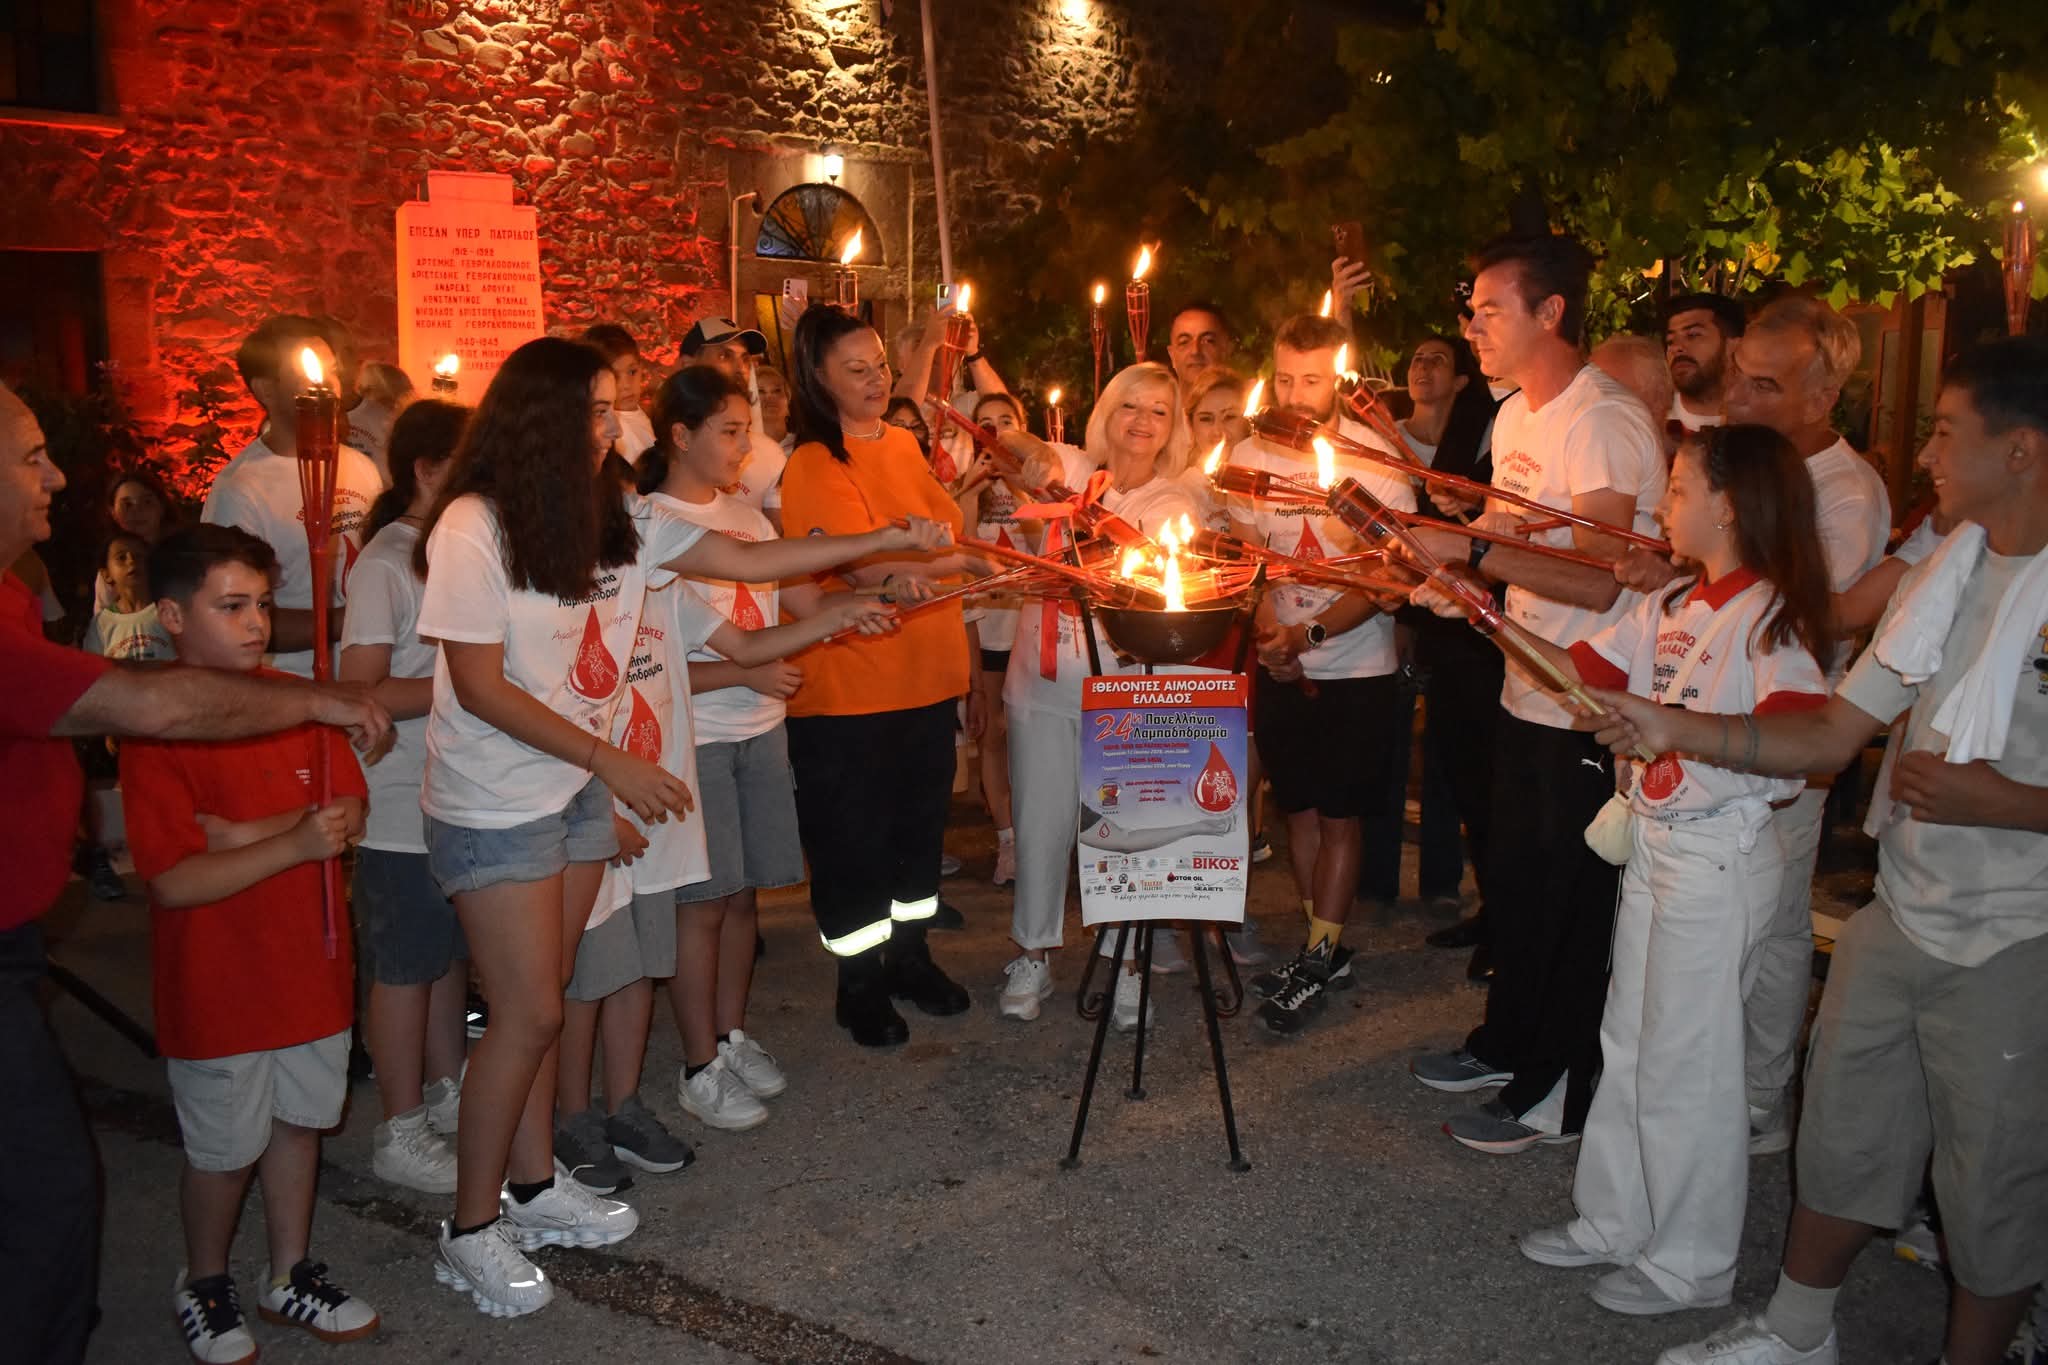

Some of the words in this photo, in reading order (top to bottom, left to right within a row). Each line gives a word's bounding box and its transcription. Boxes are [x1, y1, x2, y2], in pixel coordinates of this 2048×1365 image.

[409, 226, 448, 238] ΕΠΕΣΑΝ
[455, 227, 480, 239] ΥΠΕΡ
[490, 229, 535, 241] ΠΑΤΡΙΔΟΣ
[435, 283, 471, 293] ΑΝΔΡΕΑΣ
[424, 295, 480, 305] ΚΩΝΣΤΑΝΤΙΝΟΣ
[1092, 681, 1160, 693] ΕΘΕΛΟΝΤΕΣ
[1163, 680, 1236, 691] ΑΙΜΟΔΟΤΕΣ
[1133, 693, 1192, 704] ΕΛΛΑΔΟΣ
[1145, 712, 1215, 725] Πανελλήνια
[1133, 727, 1228, 740] Λαμπαδηδρομία
[1192, 857, 1240, 871] ΒΙΚΟΣ
